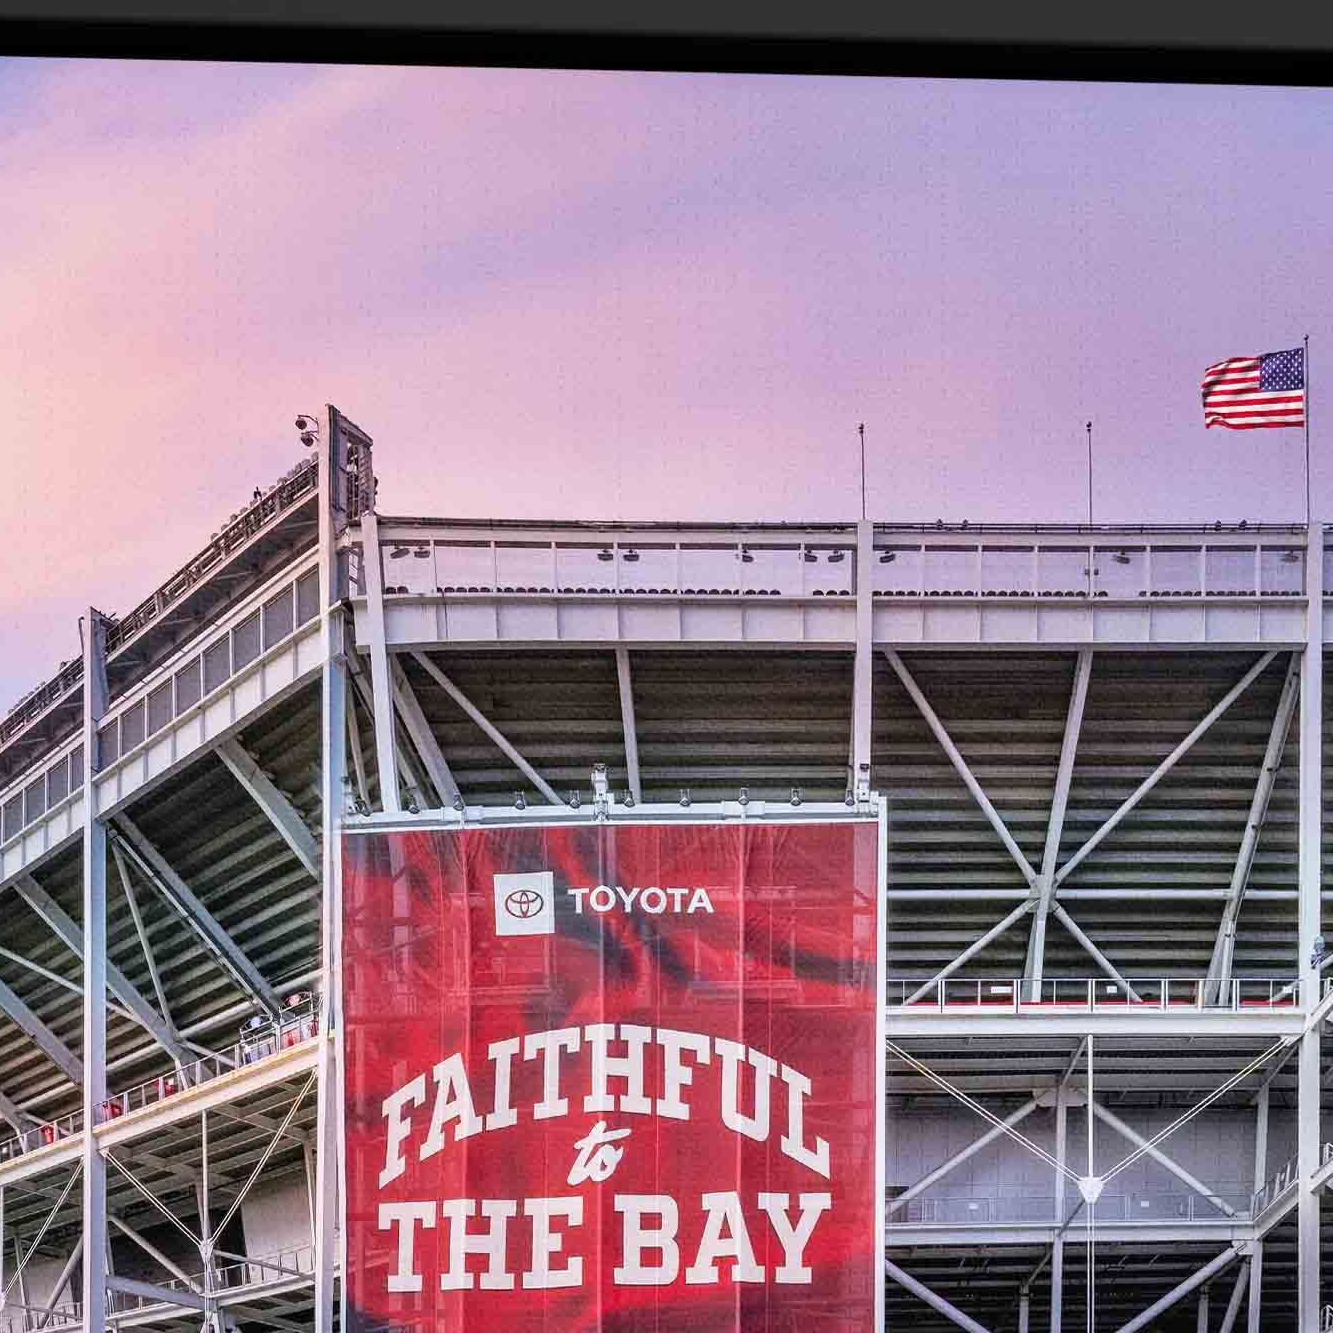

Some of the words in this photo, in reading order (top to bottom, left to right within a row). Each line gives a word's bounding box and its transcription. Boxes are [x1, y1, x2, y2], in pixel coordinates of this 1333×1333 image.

[567, 885, 714, 915] TOYOTA
[377, 1021, 830, 1189] FAITHFUL
[566, 1119, 632, 1186] to
[377, 1196, 585, 1293] THE
[612, 1190, 832, 1286] BAY
